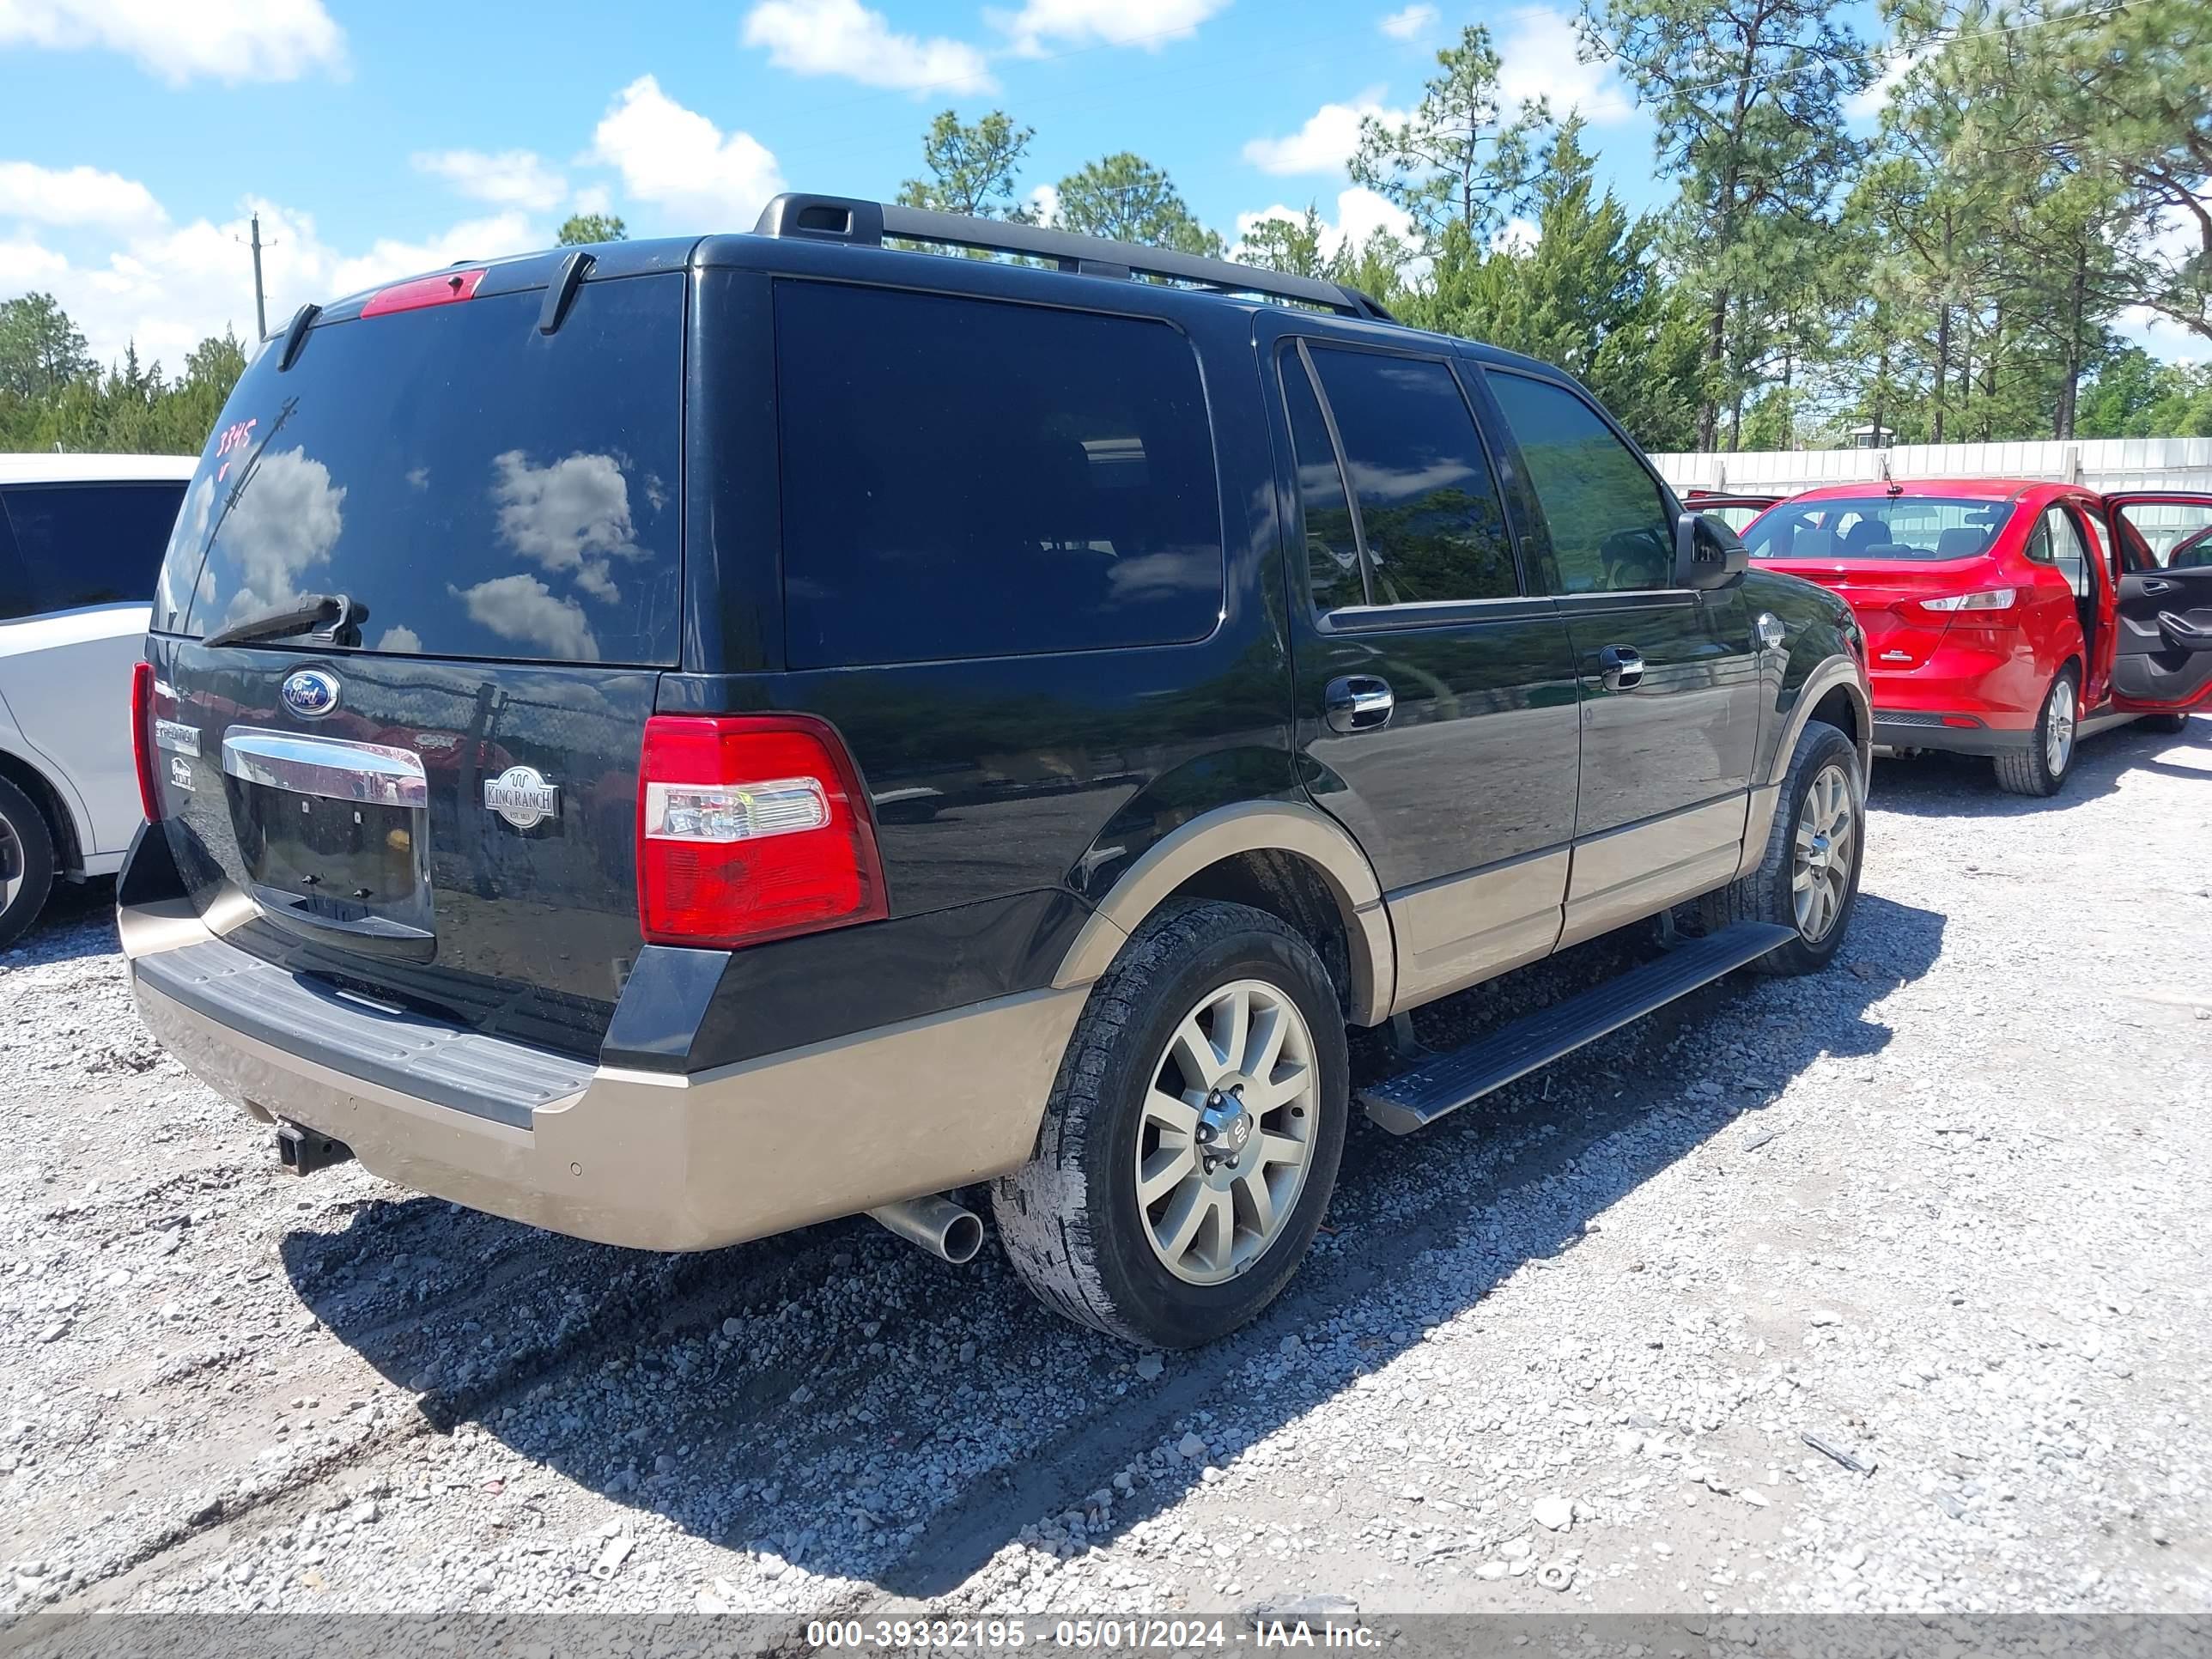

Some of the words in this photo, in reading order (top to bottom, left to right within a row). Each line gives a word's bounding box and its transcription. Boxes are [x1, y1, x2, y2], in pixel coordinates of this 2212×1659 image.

[216, 418, 257, 458] 3345
[289, 678, 319, 704] Ford
[487, 786, 513, 806] KING
[514, 791, 550, 810] RANCH
